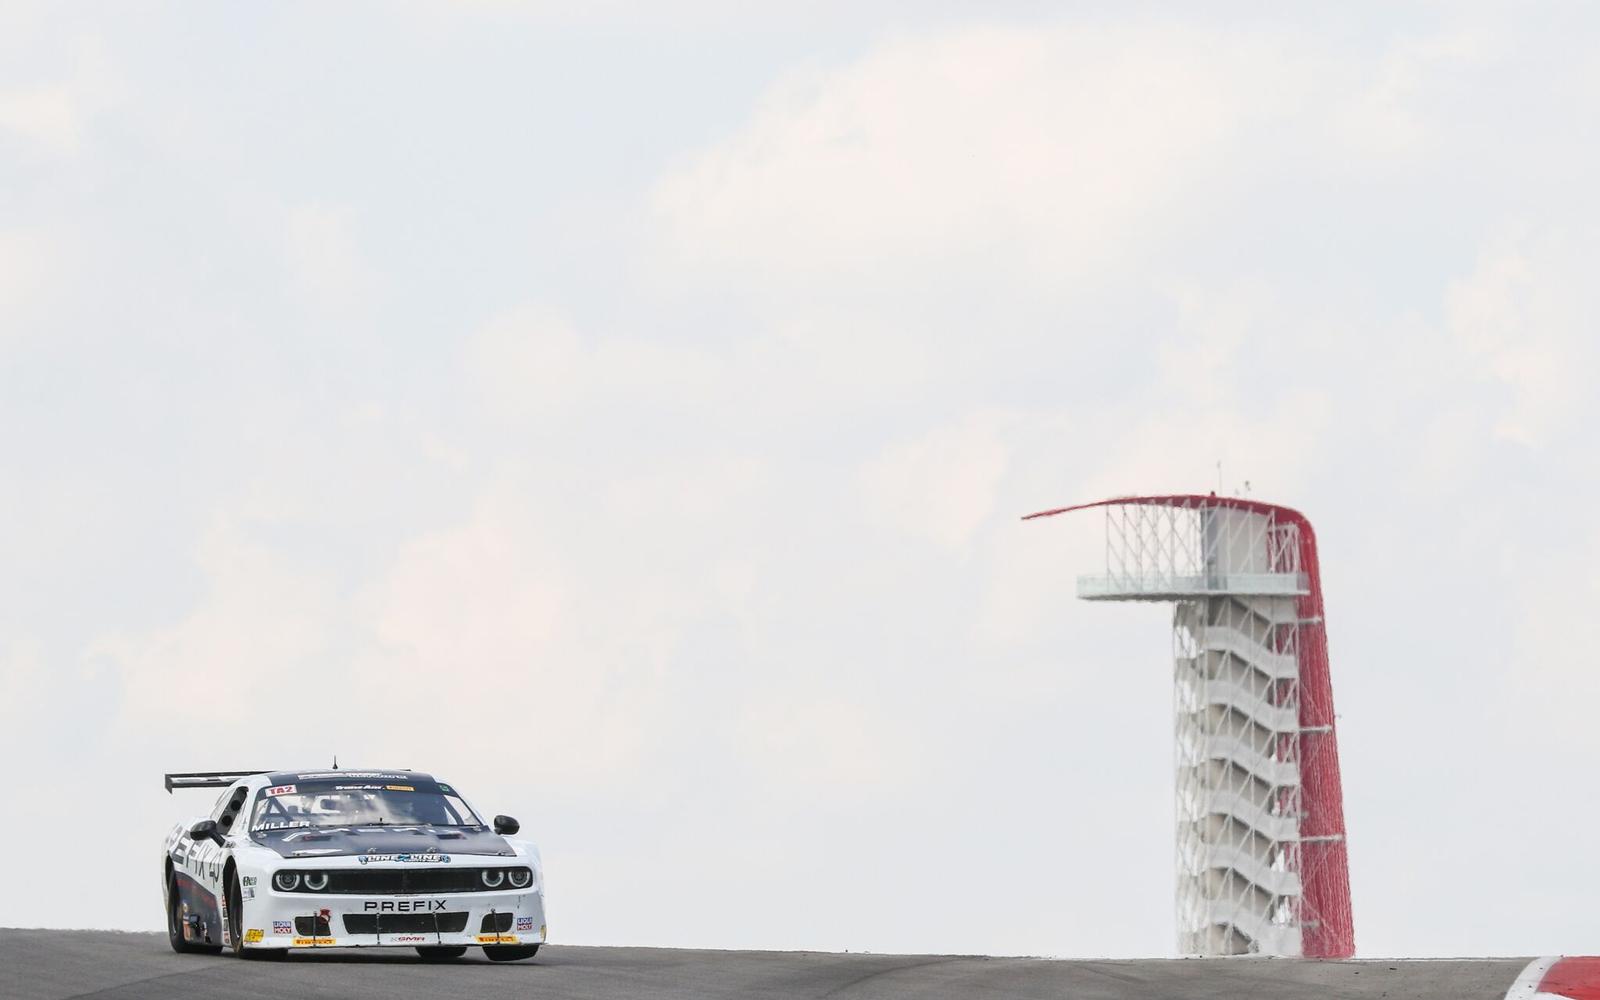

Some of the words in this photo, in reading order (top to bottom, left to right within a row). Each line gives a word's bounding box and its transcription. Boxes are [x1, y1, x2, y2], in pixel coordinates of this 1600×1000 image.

[269, 786, 293, 794] TA2
[252, 821, 310, 831] MILLER
[364, 900, 447, 912] PREFIX
